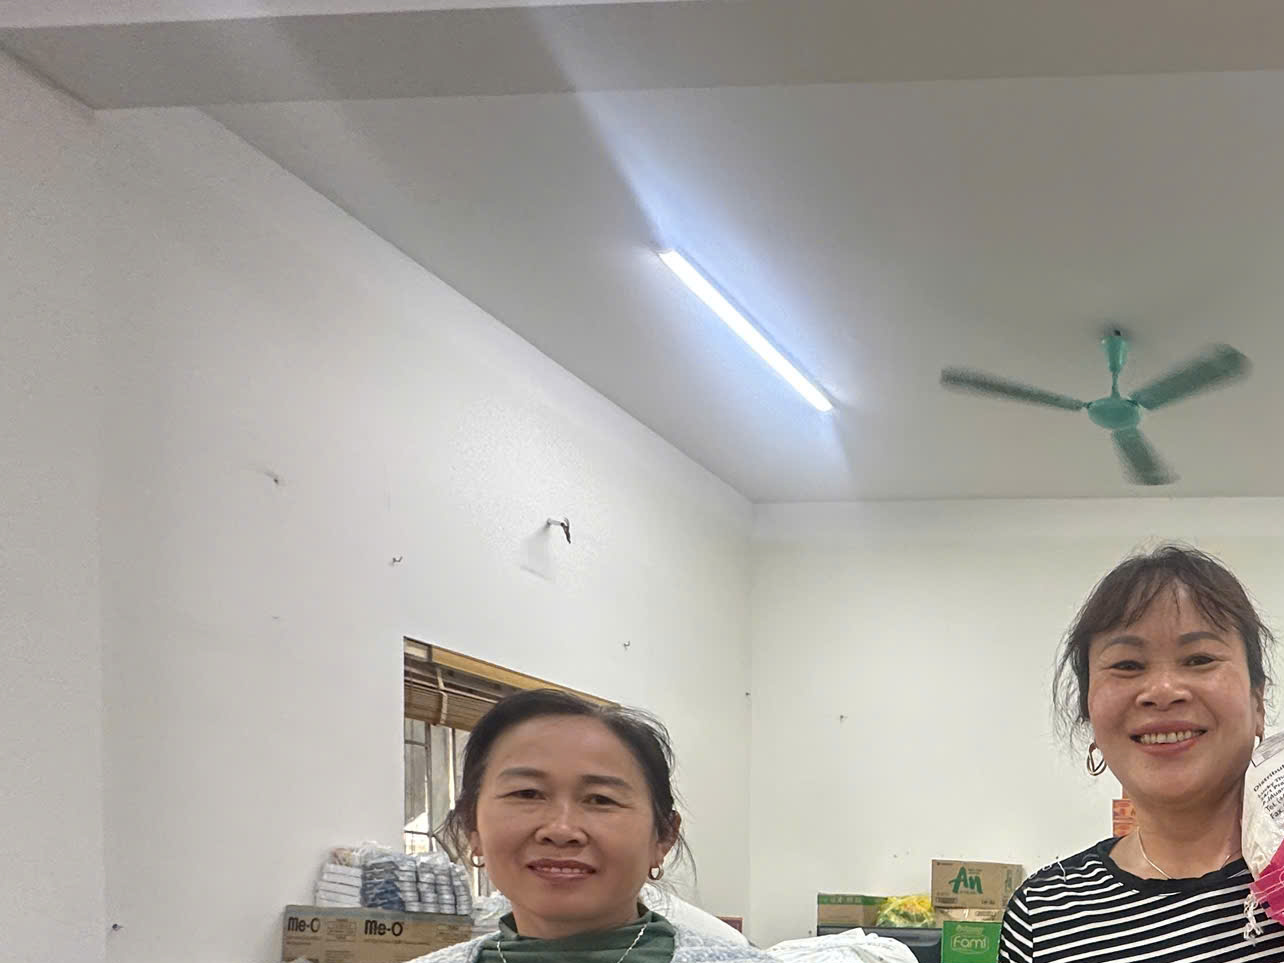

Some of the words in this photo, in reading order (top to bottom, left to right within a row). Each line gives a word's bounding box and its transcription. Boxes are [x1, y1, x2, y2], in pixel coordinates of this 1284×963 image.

[287, 916, 321, 933] Me-O
[364, 919, 404, 937] Me-O
[952, 936, 988, 950] Fami
